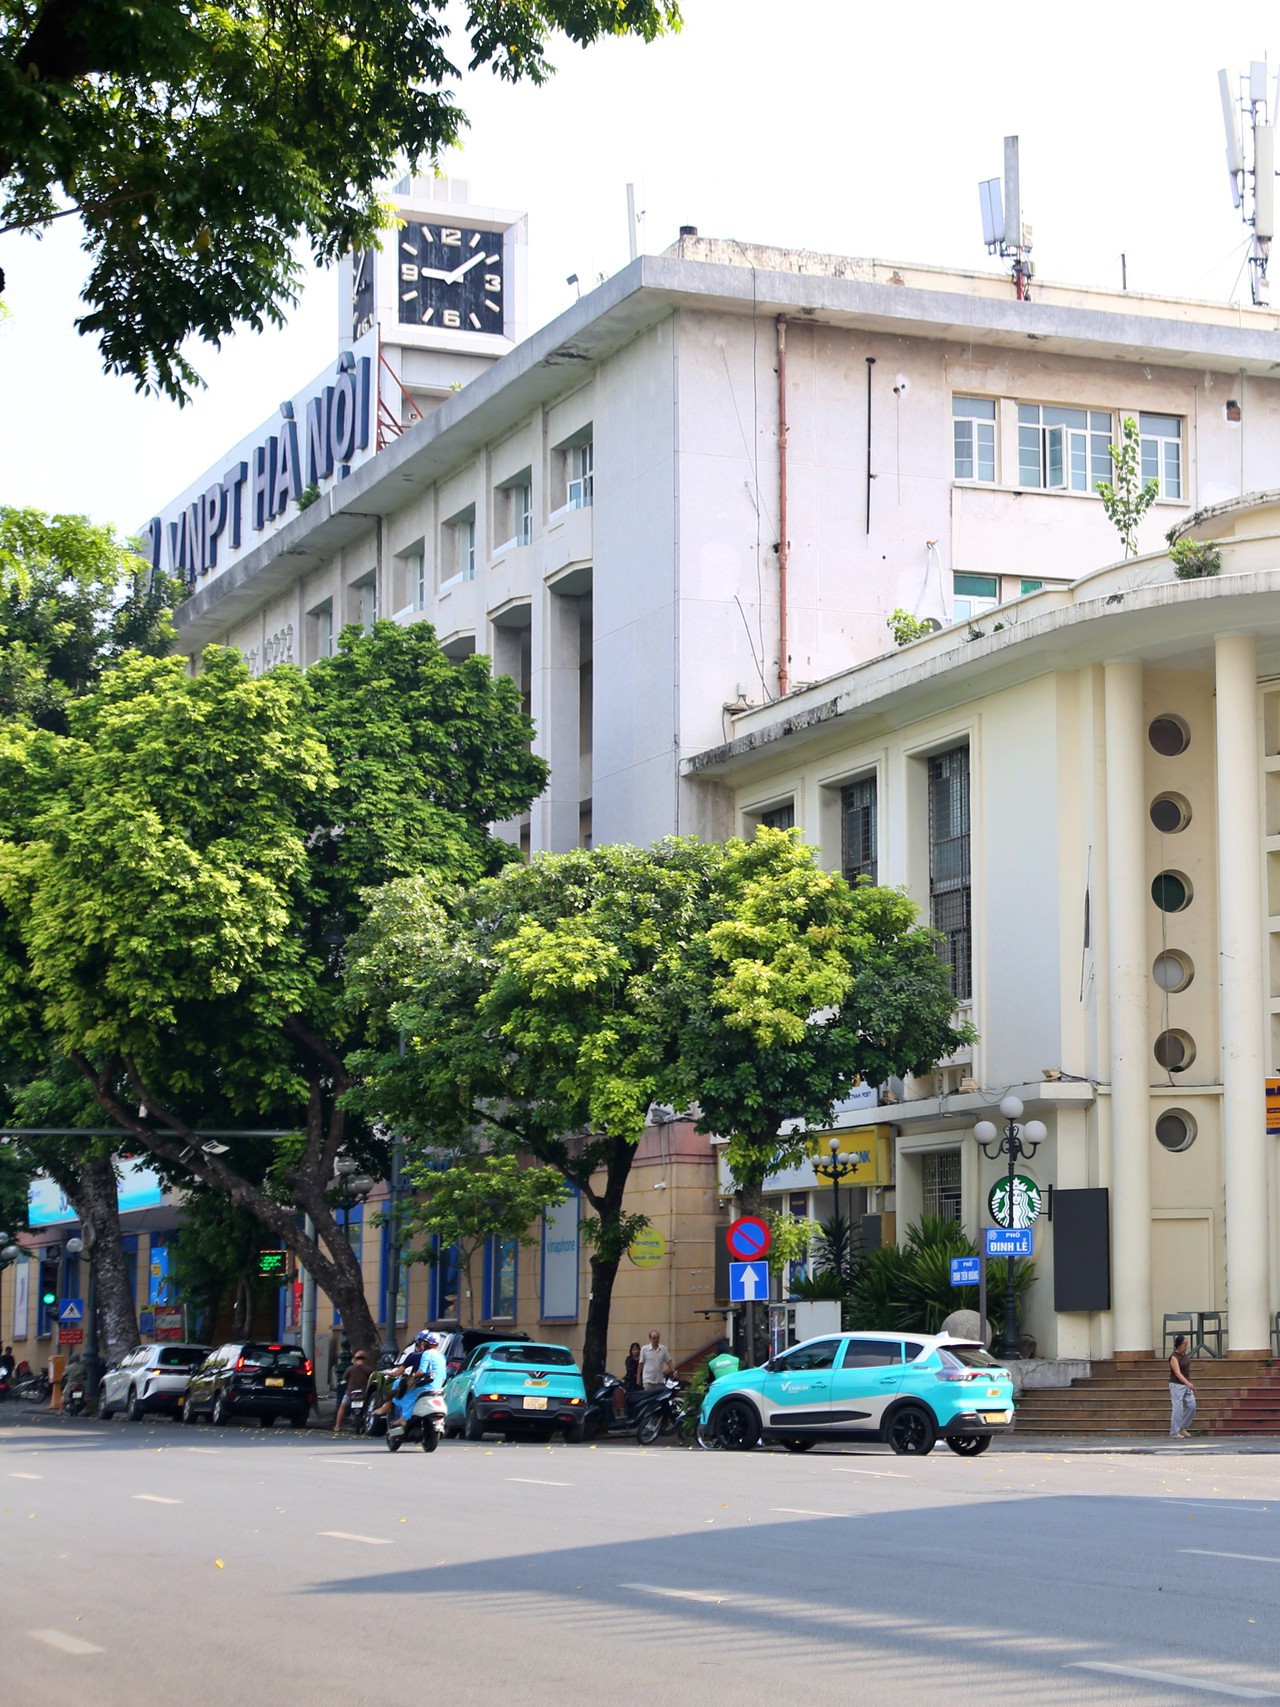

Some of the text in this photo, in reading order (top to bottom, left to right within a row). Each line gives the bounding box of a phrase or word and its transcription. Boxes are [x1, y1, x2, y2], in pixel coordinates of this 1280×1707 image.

[440, 228, 461, 246] 12
[401, 263, 418, 282] 9
[484, 274, 501, 293] 3
[442, 309, 460, 328] 6
[166, 351, 371, 583] VNPT HÀ NỘI
[990, 1242, 1014, 1252] ĐINH
